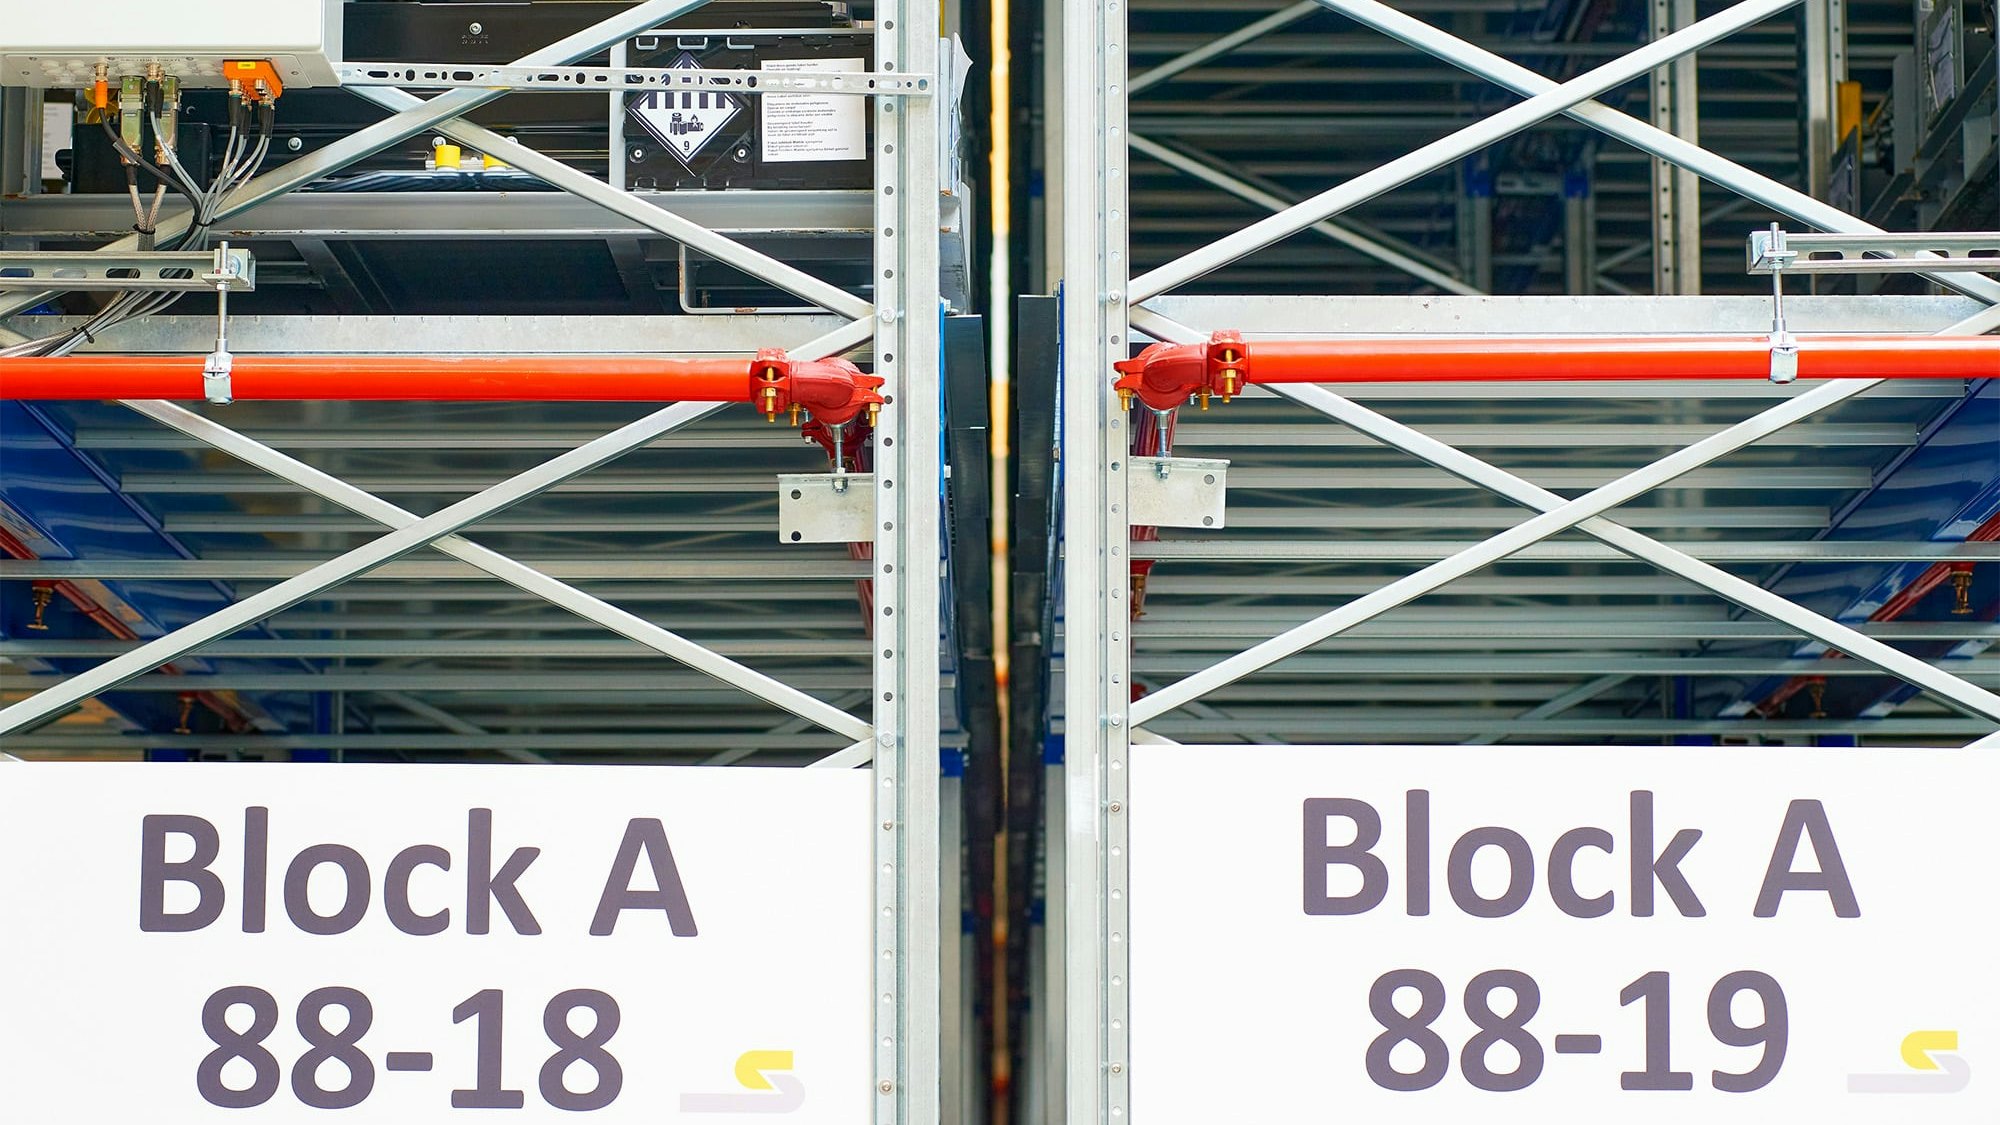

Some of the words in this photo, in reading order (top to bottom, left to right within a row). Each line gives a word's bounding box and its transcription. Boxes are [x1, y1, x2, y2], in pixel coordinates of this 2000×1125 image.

[683, 140, 691, 151] 9
[139, 805, 543, 937] Block
[588, 817, 699, 938] A
[1302, 788, 1707, 919] Block
[1752, 798, 1862, 919] A
[196, 985, 624, 1112] 88-18
[1365, 968, 1789, 1094] 88-19
